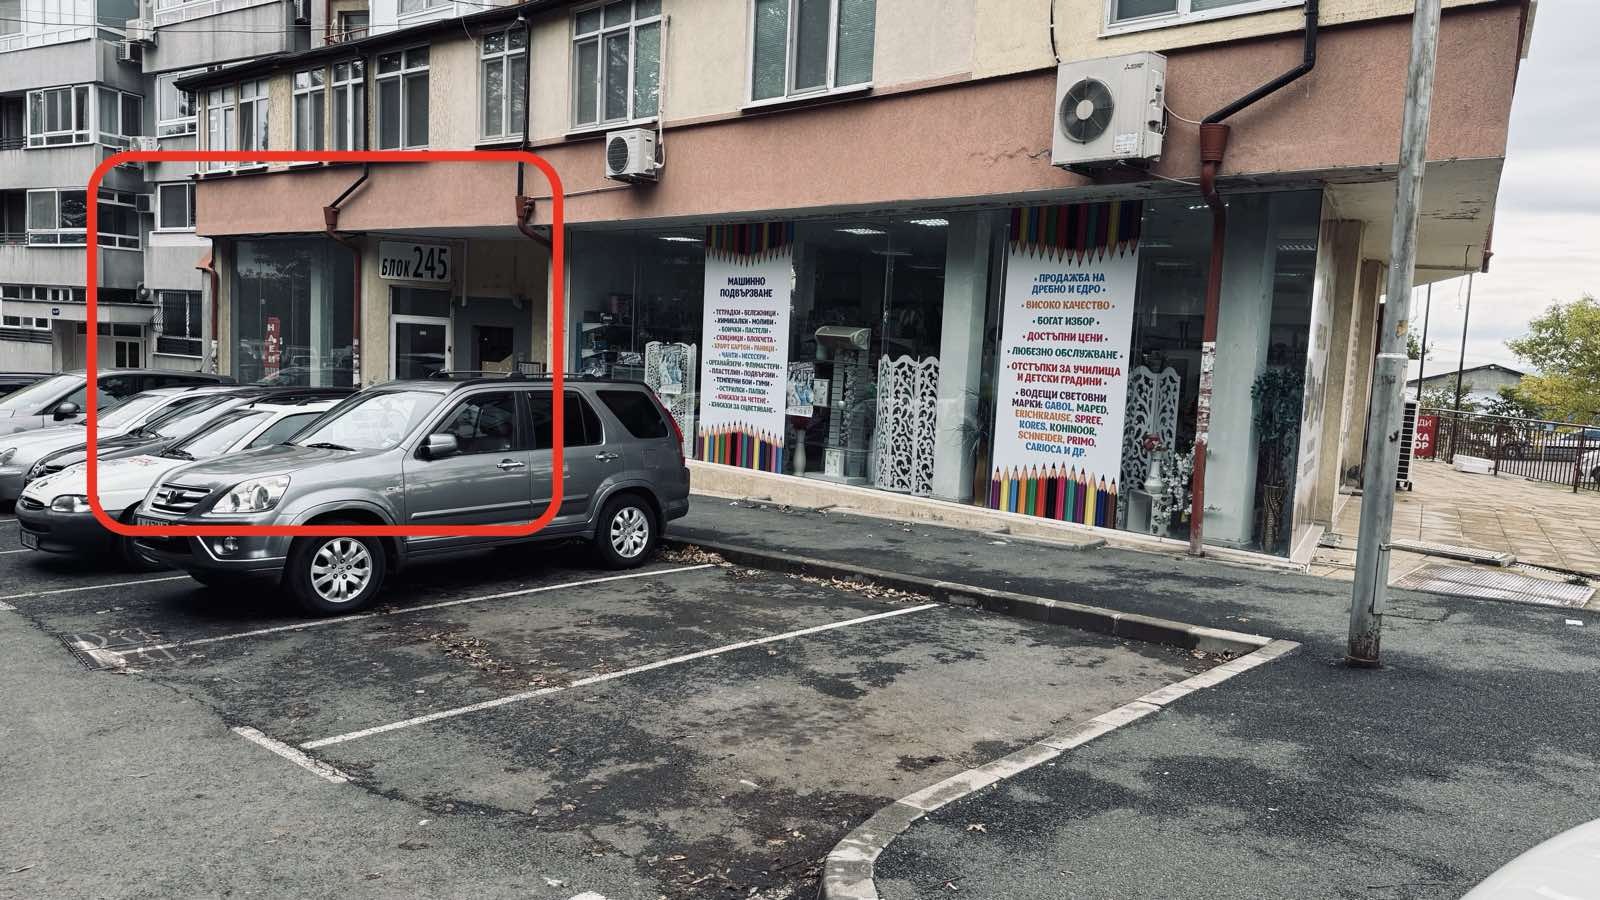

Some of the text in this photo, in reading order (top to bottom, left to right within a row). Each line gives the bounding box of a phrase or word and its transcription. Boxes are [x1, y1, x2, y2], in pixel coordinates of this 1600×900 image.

[382, 246, 447, 279] БЛОК 245
[728, 277, 766, 286] МАШИННО
[1039, 272, 1105, 284] ПРОДАЖБА НА
[720, 289, 774, 299] ПОДВЪРЗВАНЕ
[1032, 284, 1100, 295] ДРЕБНО И ЕДРО
[1026, 300, 1110, 310] ВИСОКО КАЧЕСТВО
[1037, 316, 1095, 326] БОГАТ ИЗБОР
[1027, 331, 1103, 344] ДОСТЪПНИ ЦЕНИ
[1011, 346, 1118, 360] ЛЮБЕЗНО ОБСЛУЖВАНЕ
[1011, 361, 1120, 377] ОТСТЪПКИ ЗА УЧИЛИЩА
[1017, 372, 1102, 387] И ДЕТСКИ ГРАДИНИ
[1020, 388, 1107, 403] ВОДЕЩИ СВЕТОВНИ
[1012, 398, 1043, 409] МАРКИ:
[1076, 403, 1109, 415] MAPED,
[1074, 414, 1104, 426] SPREE,
[1019, 420, 1097, 437] KORES, KOHINOOR,
[1018, 430, 1096, 447] SCHNEIDER, PRIMO,
[1025, 442, 1087, 458] CARIOCA И ДР.
